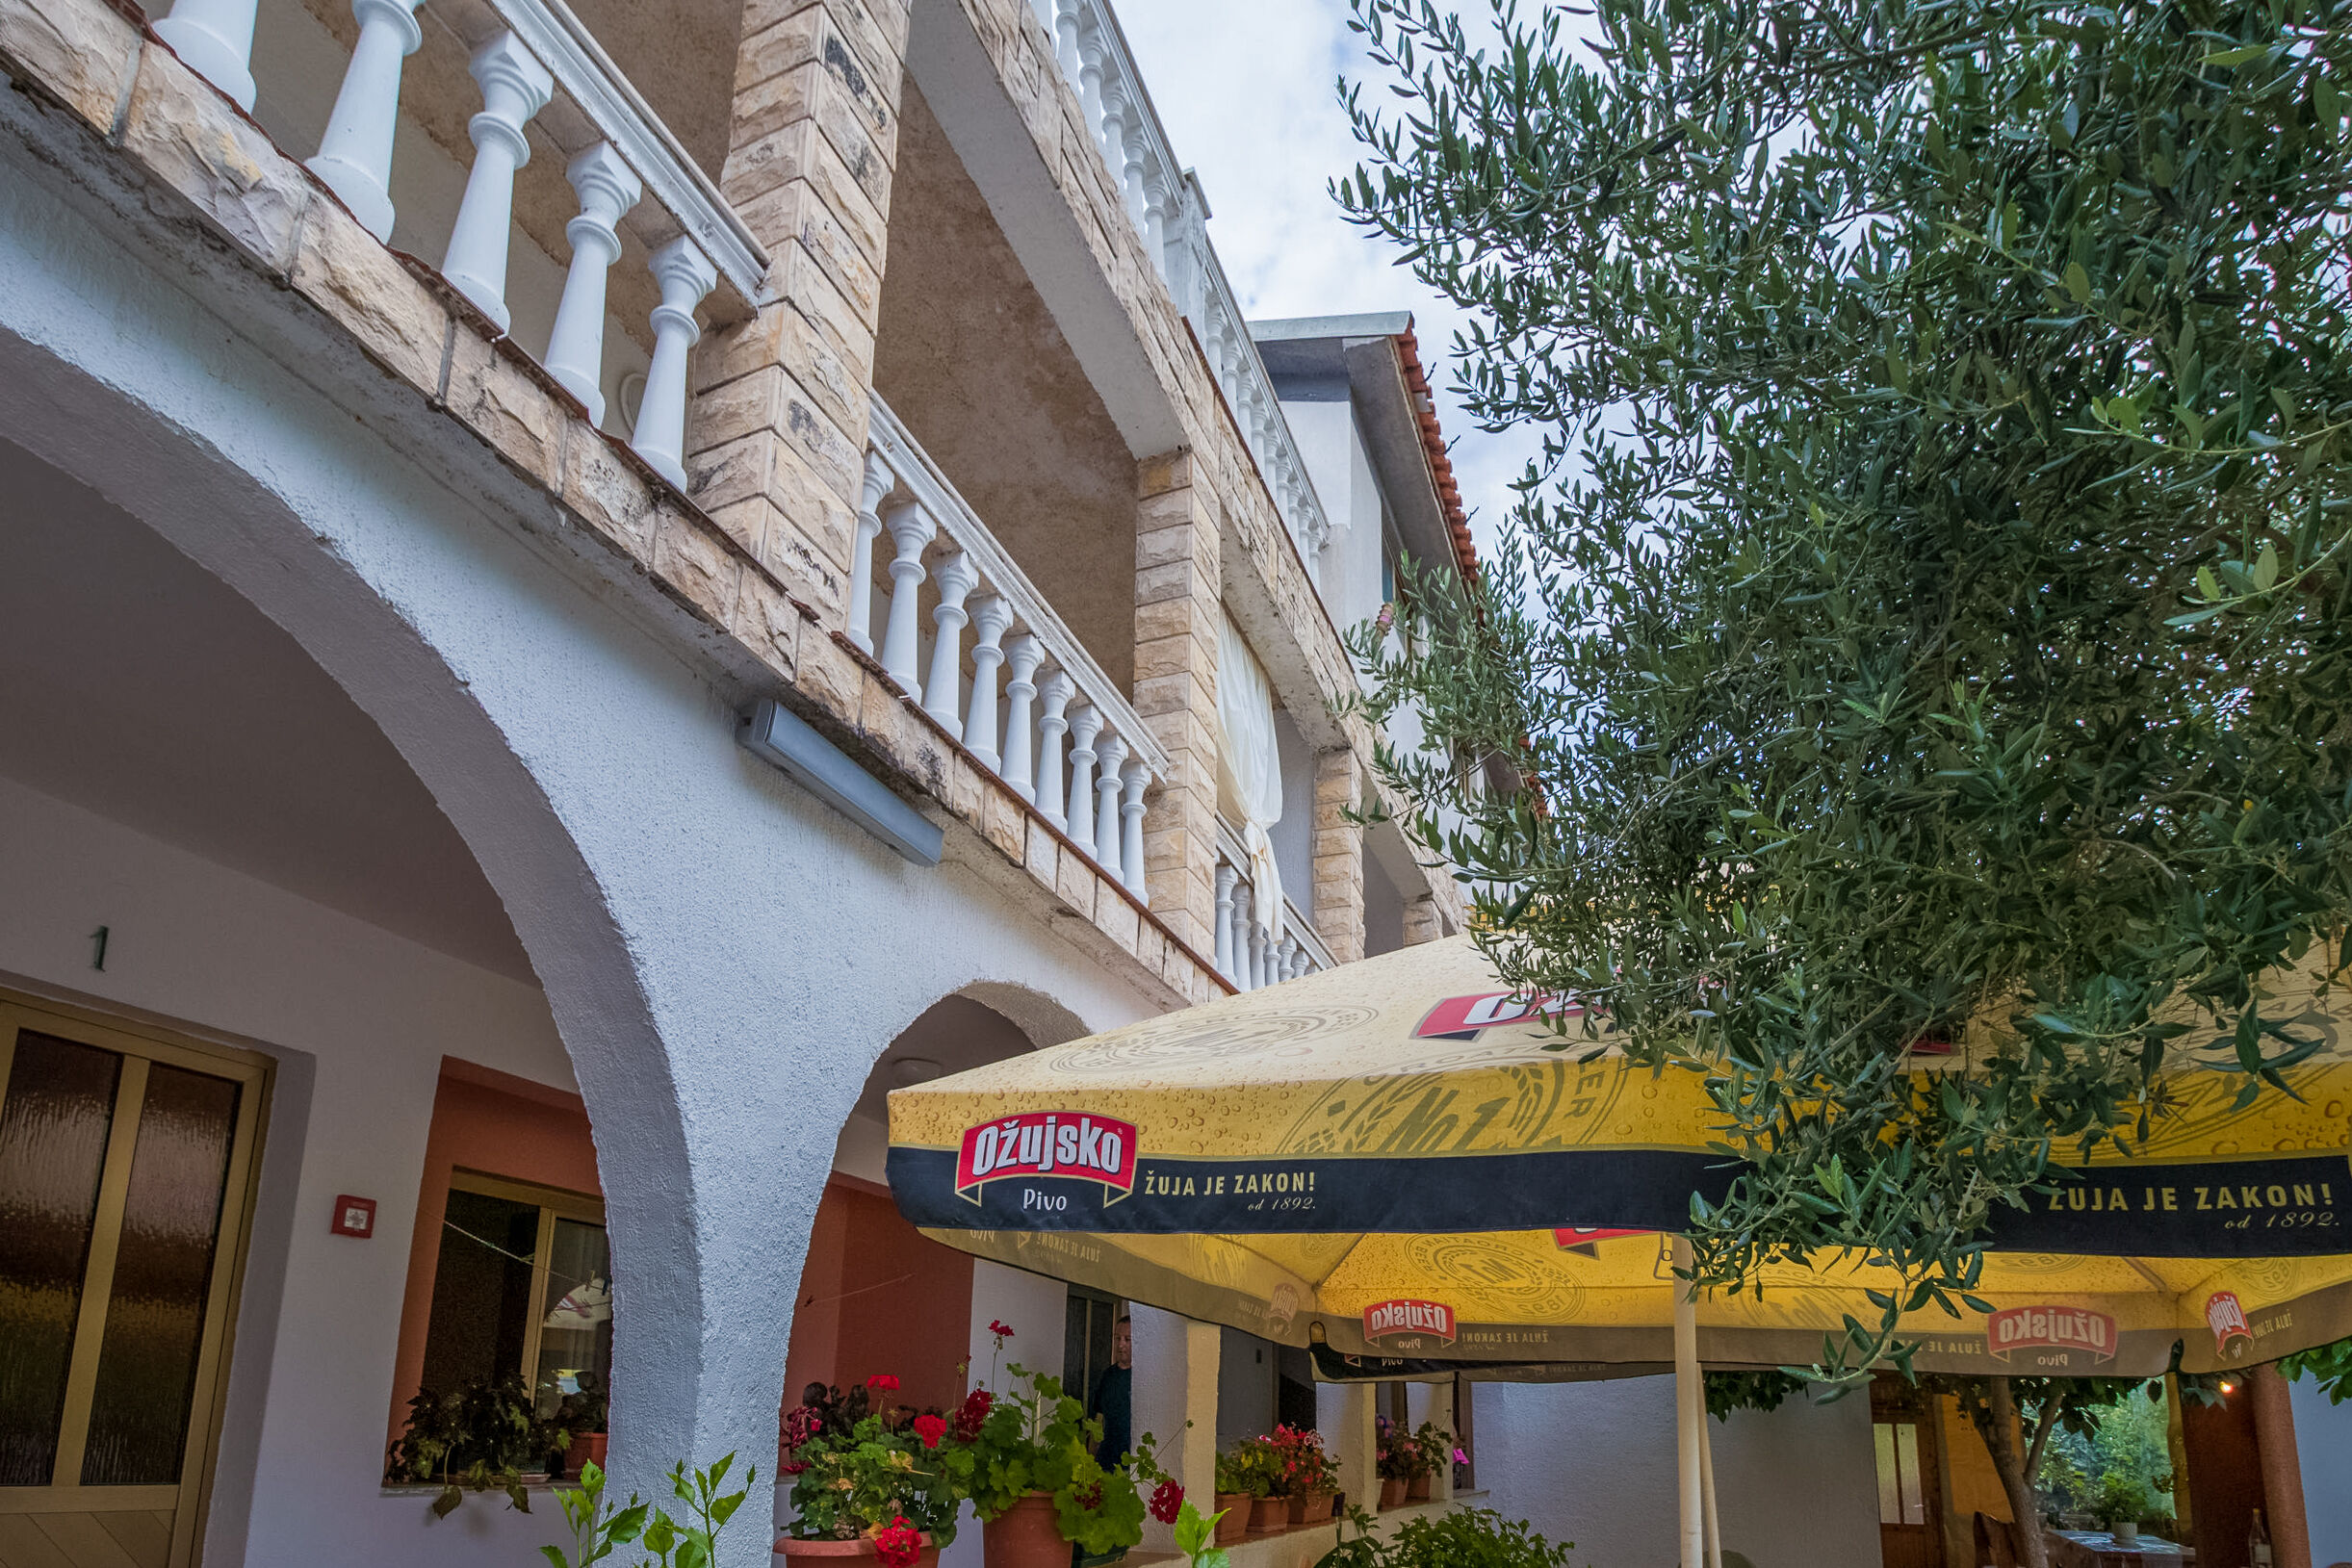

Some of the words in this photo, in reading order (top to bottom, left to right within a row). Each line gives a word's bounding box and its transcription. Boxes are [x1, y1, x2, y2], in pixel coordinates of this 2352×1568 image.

[91, 925, 109, 971] 1
[972, 1116, 1122, 1177] Ožujsko
[1145, 1170, 1196, 1195] ŽUJA
[1203, 1176, 1226, 1195] JE
[1233, 1171, 1315, 1194] ZAKON!
[1022, 1188, 1068, 1211] Pivo
[1248, 1198, 1265, 1211] od
[1272, 1196, 1316, 1211] 1892.
[2048, 1179, 2129, 1212] ŽUJA
[2143, 1187, 2179, 1211] JE
[2194, 1183, 2334, 1211] ZAKON!
[2225, 1215, 2252, 1229] od
[2265, 1211, 2340, 1229] 1892.
